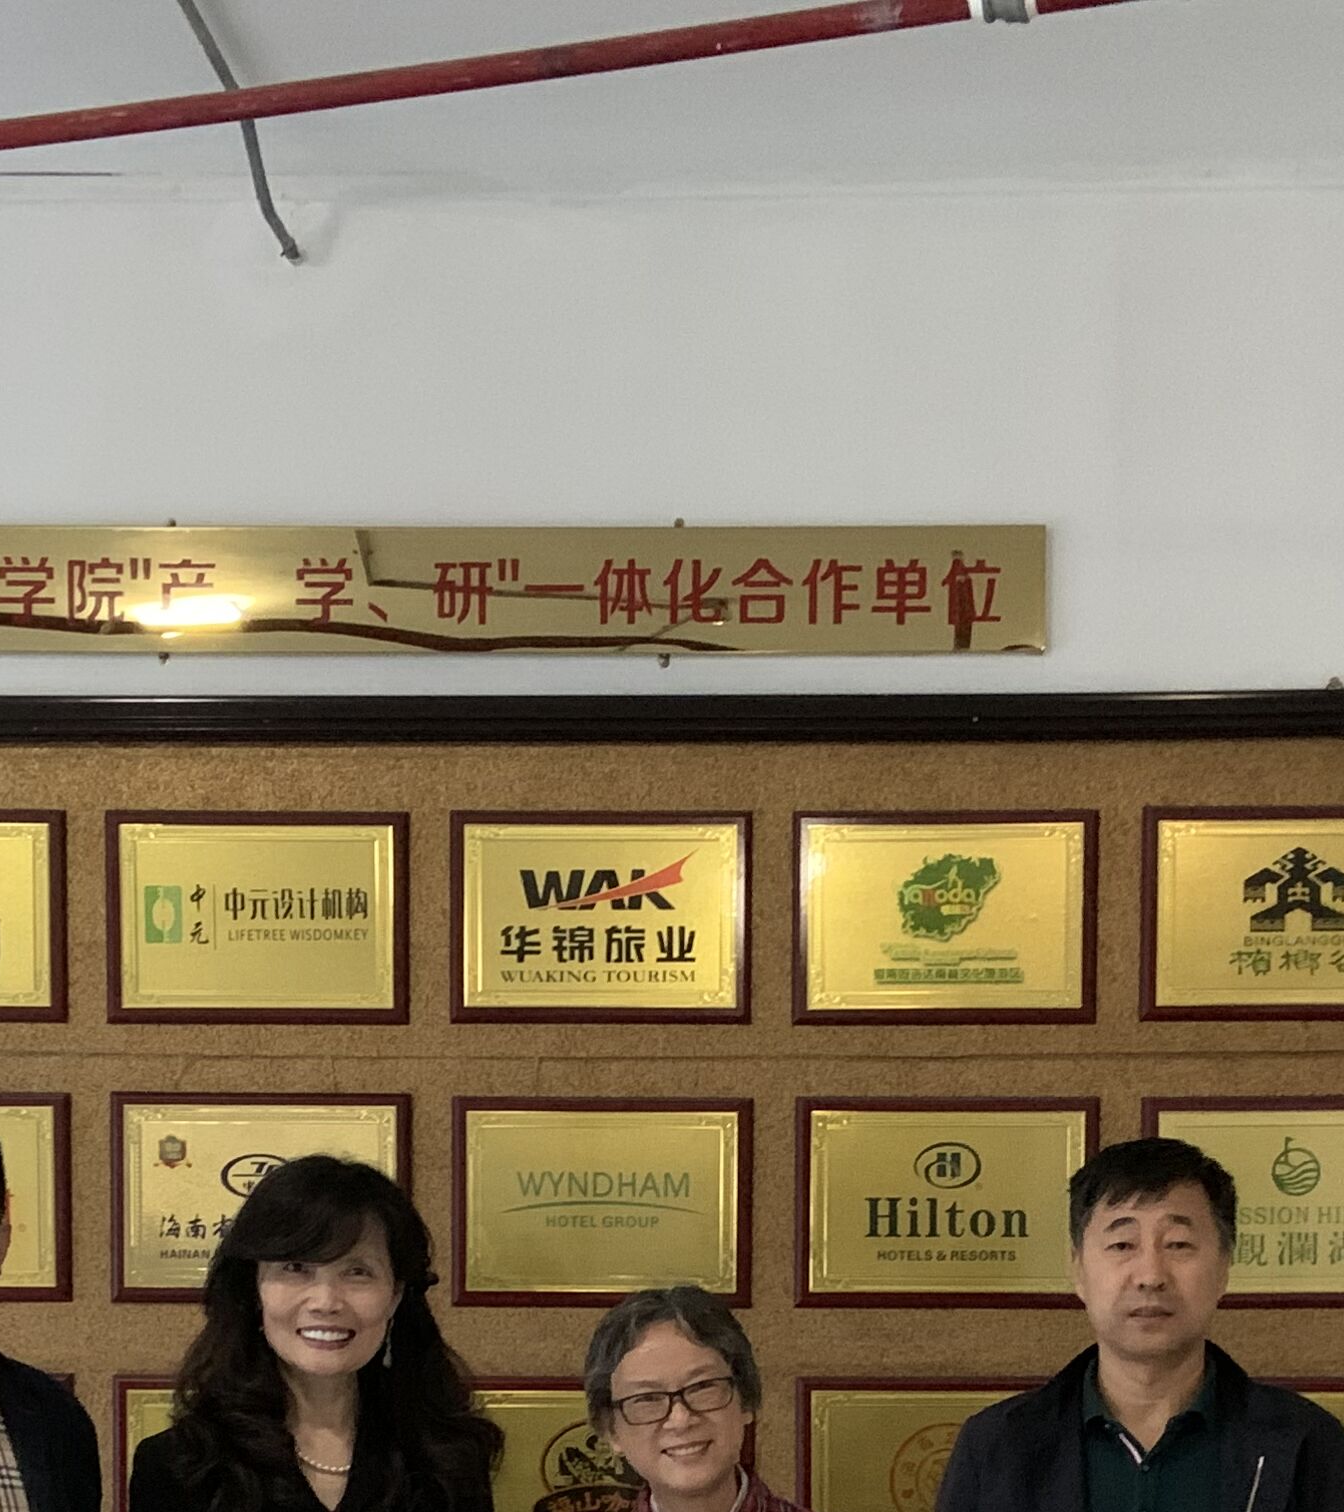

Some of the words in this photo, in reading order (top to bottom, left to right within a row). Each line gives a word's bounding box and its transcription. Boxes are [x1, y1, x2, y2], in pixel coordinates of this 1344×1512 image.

[225, 887, 368, 920] 中元设计机构
[228, 928, 286, 941] LIFETREE
[290, 928, 368, 941] WISDOMKEY
[500, 925, 696, 963] 华锦旅业
[500, 970, 597, 983] WUAKING
[604, 970, 696, 983] TOURISM
[517, 1170, 690, 1198] WYNDHAM
[546, 1216, 597, 1228] HOTEL
[602, 1216, 660, 1228] GROUP
[864, 1197, 1029, 1238] Hilton
[160, 1249, 210, 1260] HAINAN
[877, 1250, 933, 1262] HOTELS
[936, 1250, 948, 1262] &
[950, 1250, 1017, 1262] RESORTS
